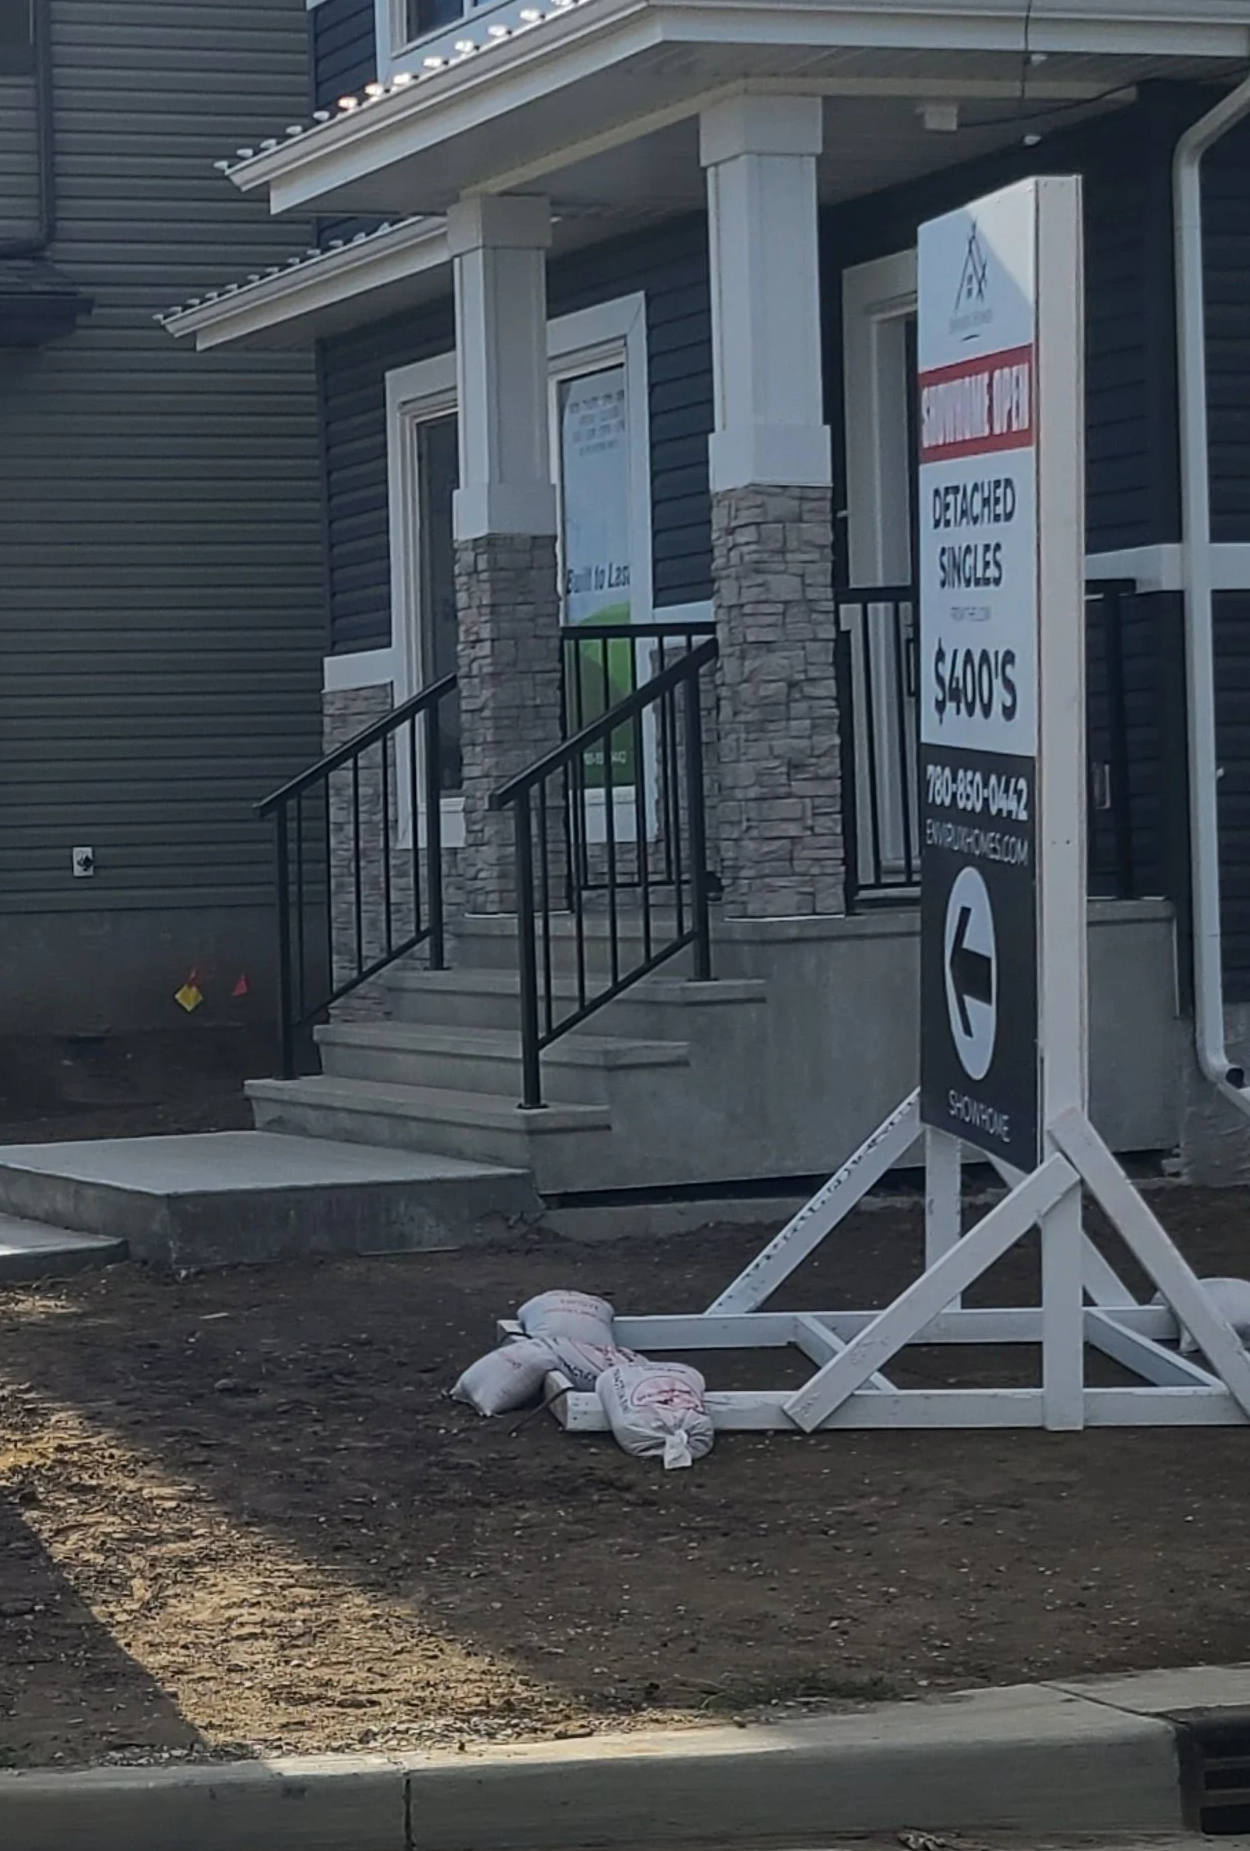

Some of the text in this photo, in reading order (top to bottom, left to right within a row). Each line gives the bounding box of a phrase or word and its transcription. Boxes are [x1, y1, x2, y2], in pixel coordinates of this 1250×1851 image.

[921, 361, 1030, 449] SHOWHOME OPEN
[932, 476, 1017, 530] DETACHED
[938, 541, 1003, 589] SINGLES
[933, 636, 1018, 727] $400'S
[926, 763, 1029, 821] 780-850-0442
[948, 1088, 1011, 1143] SHOWHOME
